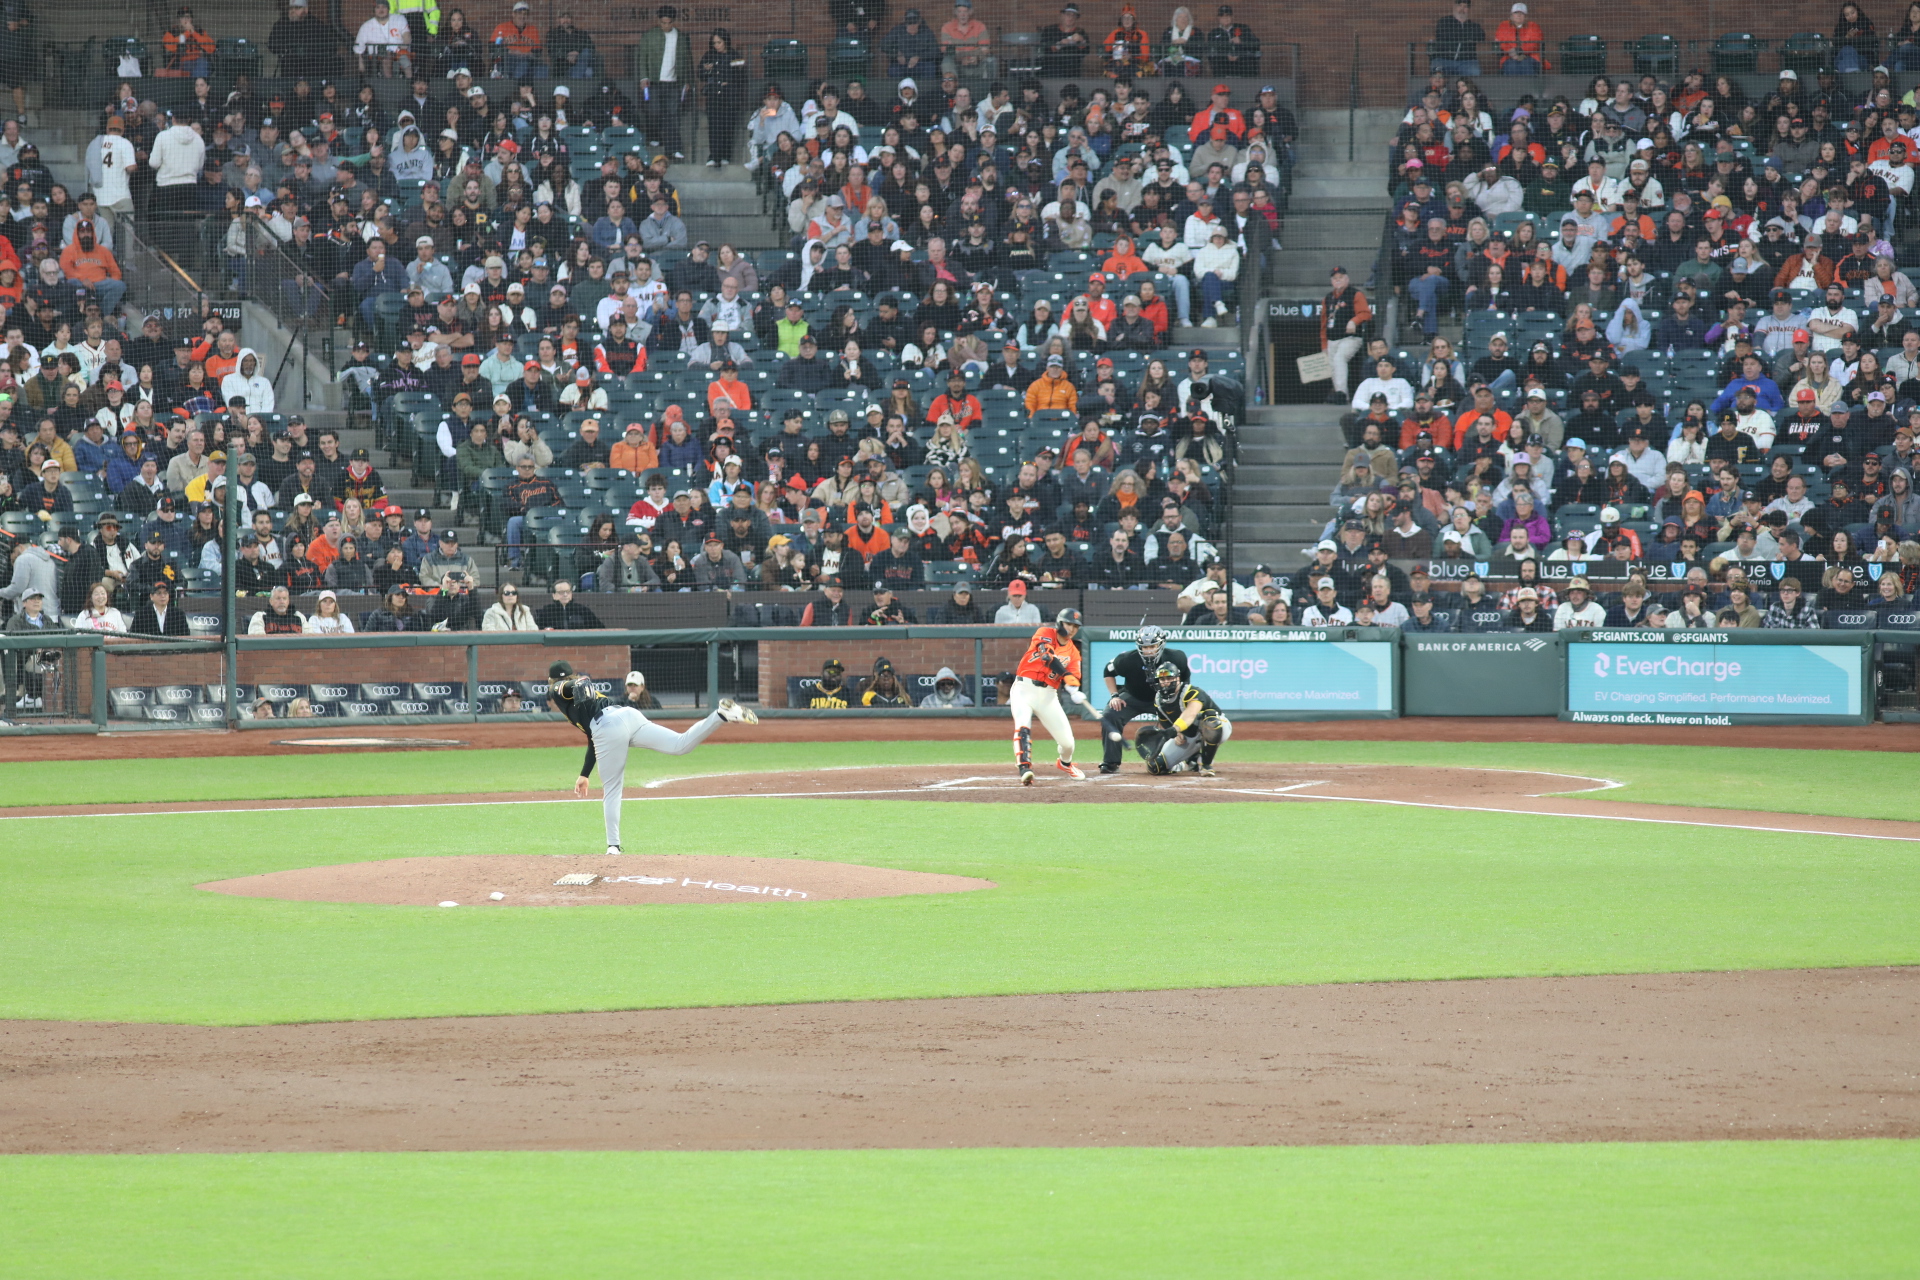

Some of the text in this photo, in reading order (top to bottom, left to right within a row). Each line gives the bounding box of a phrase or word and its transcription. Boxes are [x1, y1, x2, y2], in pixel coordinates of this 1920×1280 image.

[1269, 304, 1299, 316] blue
[1788, 425, 1820, 434] GIANTS
[1429, 561, 1469, 577] blue
[1540, 561, 1568, 578] lue
[1109, 630, 1139, 640] MOTH
[1164, 630, 1184, 640] DAY
[1186, 630, 1230, 641] QUILTED
[1231, 630, 1257, 640] TOTE
[1258, 630, 1281, 640] BAG
[1288, 631, 1311, 641] MAY
[1314, 631, 1327, 641] 10
[1592, 631, 1729, 643] SFGIANTS.COM @SFGIANTS
[1417, 643, 1521, 652] BANK OF AMERICA
[1187, 653, 1269, 679] Charge
[1616, 655, 1741, 681] EverCharge
[1236, 690, 1302, 700] Performance
[1304, 690, 1361, 700] Maximized.
[1594, 691, 1833, 704] EV Charging Simplified. Performance Maximized.
[810, 697, 848, 709] PIRATES
[1572, 711, 1732, 726] Always on deck. Never on hold.
[681, 877, 808, 899] Health
